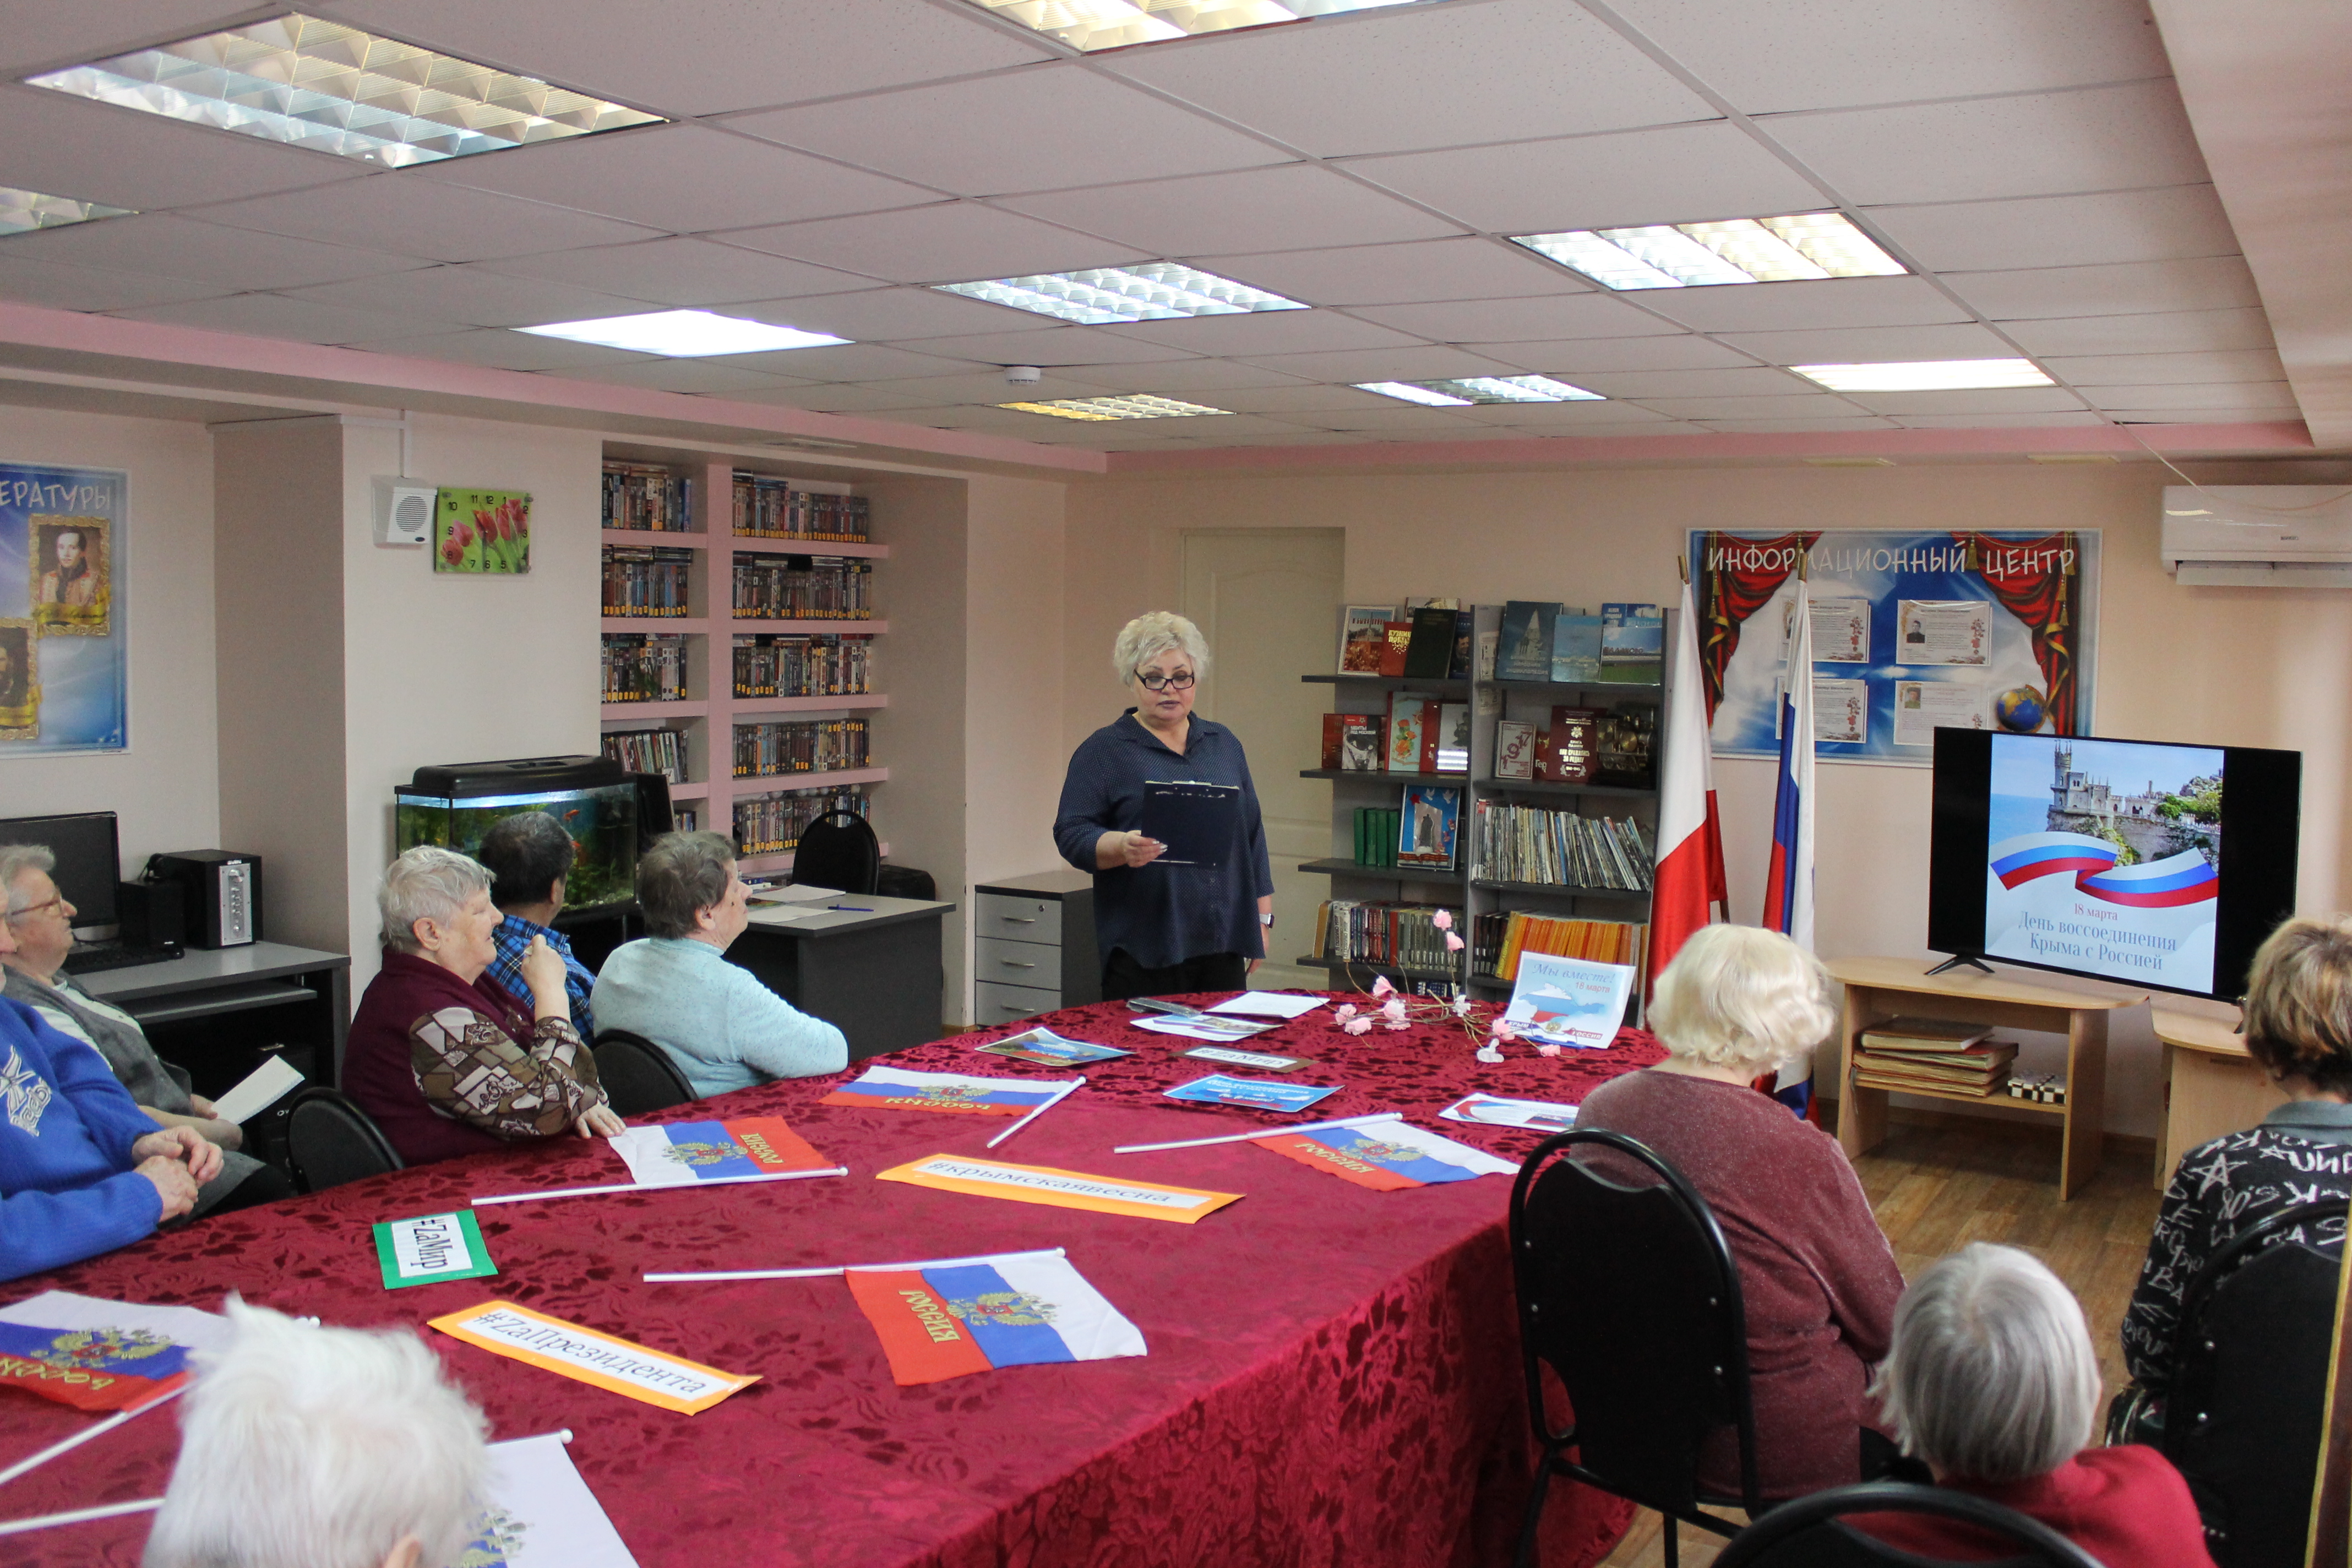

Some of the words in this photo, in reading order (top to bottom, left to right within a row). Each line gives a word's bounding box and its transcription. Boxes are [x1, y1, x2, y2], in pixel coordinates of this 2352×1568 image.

[486, 495, 494, 504] 12
[522, 505, 529, 514] 2
[448, 526, 454, 535] 9
[470, 560, 476, 568] 7
[485, 560, 491, 569] 6
[501, 560, 507, 569] 5
[1709, 540, 1966, 579] ИНФОРМАЦИОННЫЙ
[1986, 548, 2075, 582] ЦЕНТР
[2074, 903, 2084, 915] 18
[2087, 908, 2118, 921] марта
[2018, 911, 2054, 930] День
[2059, 921, 2176, 951] воссоединения
[2030, 933, 2080, 955] Крыма
[2086, 947, 2093, 958] с
[2099, 944, 2163, 970] Россией
[1532, 964, 1559, 977] Мы
[1562, 971, 1616, 983] вместе!
[1575, 982, 1584, 990] 18
[1587, 984, 1610, 993] марта
[739, 1133, 784, 1163] РОССИЯ
[1294, 1143, 1377, 1173] РОССИЯ
[927, 1160, 1171, 1202] #крымскаявесна
[410, 1218, 453, 1268] #ZaМир
[899, 1291, 961, 1343] РОССИЯ
[472, 1312, 707, 1393] #ZaПрезидента
